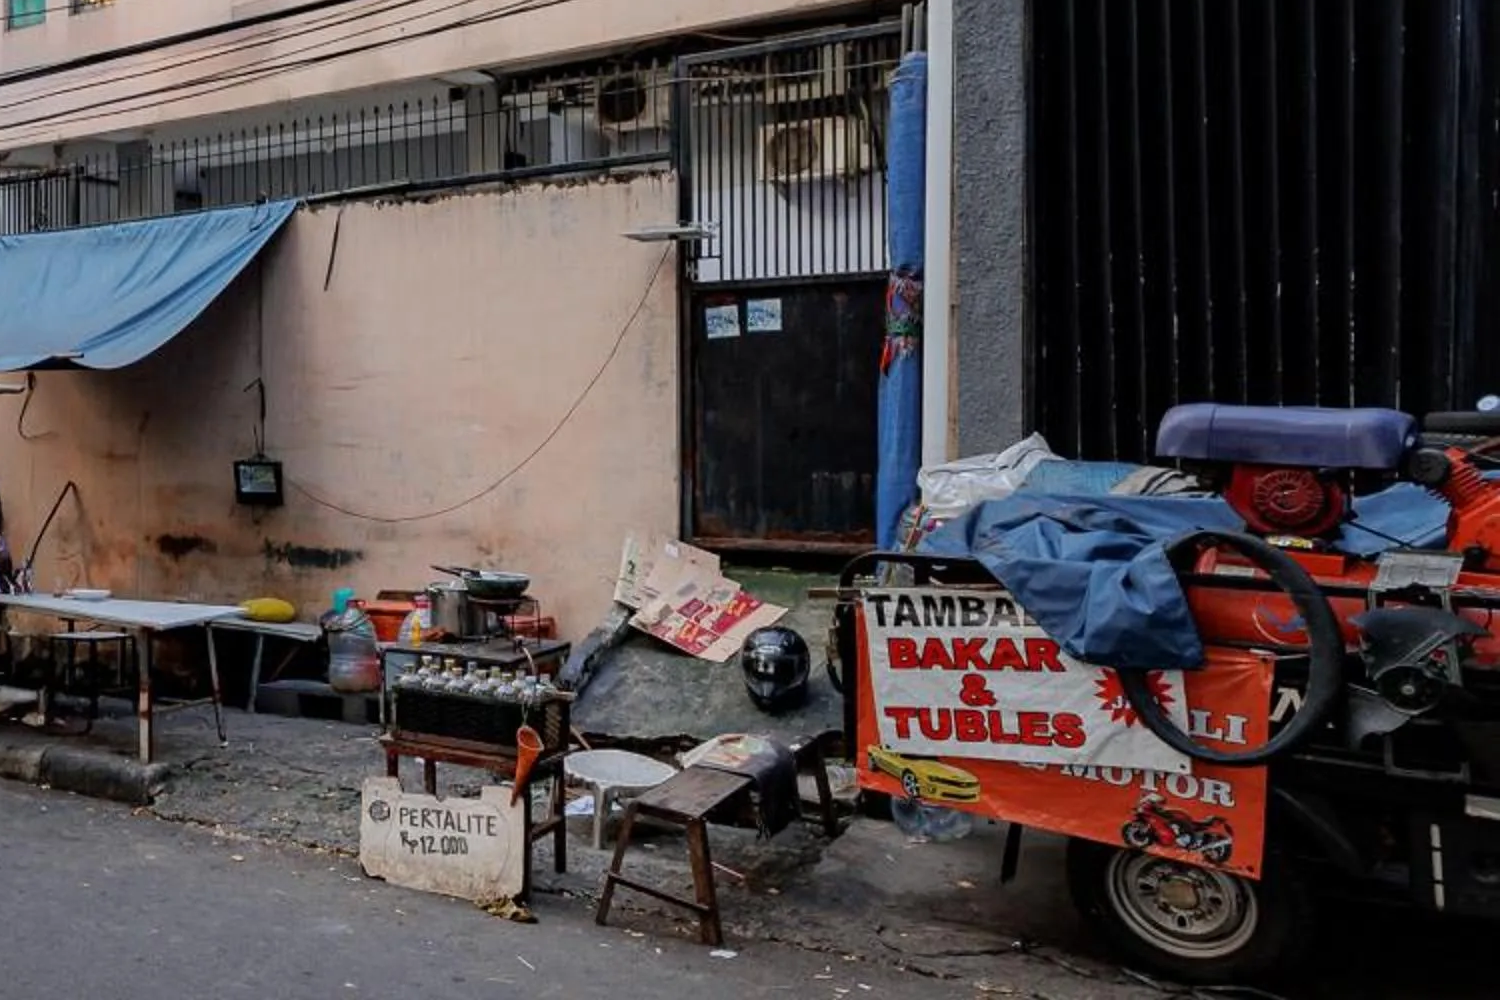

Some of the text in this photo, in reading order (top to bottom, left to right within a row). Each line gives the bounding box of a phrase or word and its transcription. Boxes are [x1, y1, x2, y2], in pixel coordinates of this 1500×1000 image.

[886, 636, 1067, 673] BAKAR
[959, 673, 998, 708] &
[883, 706, 1088, 748] TUBLES
[399, 806, 498, 837] PERTALITE
